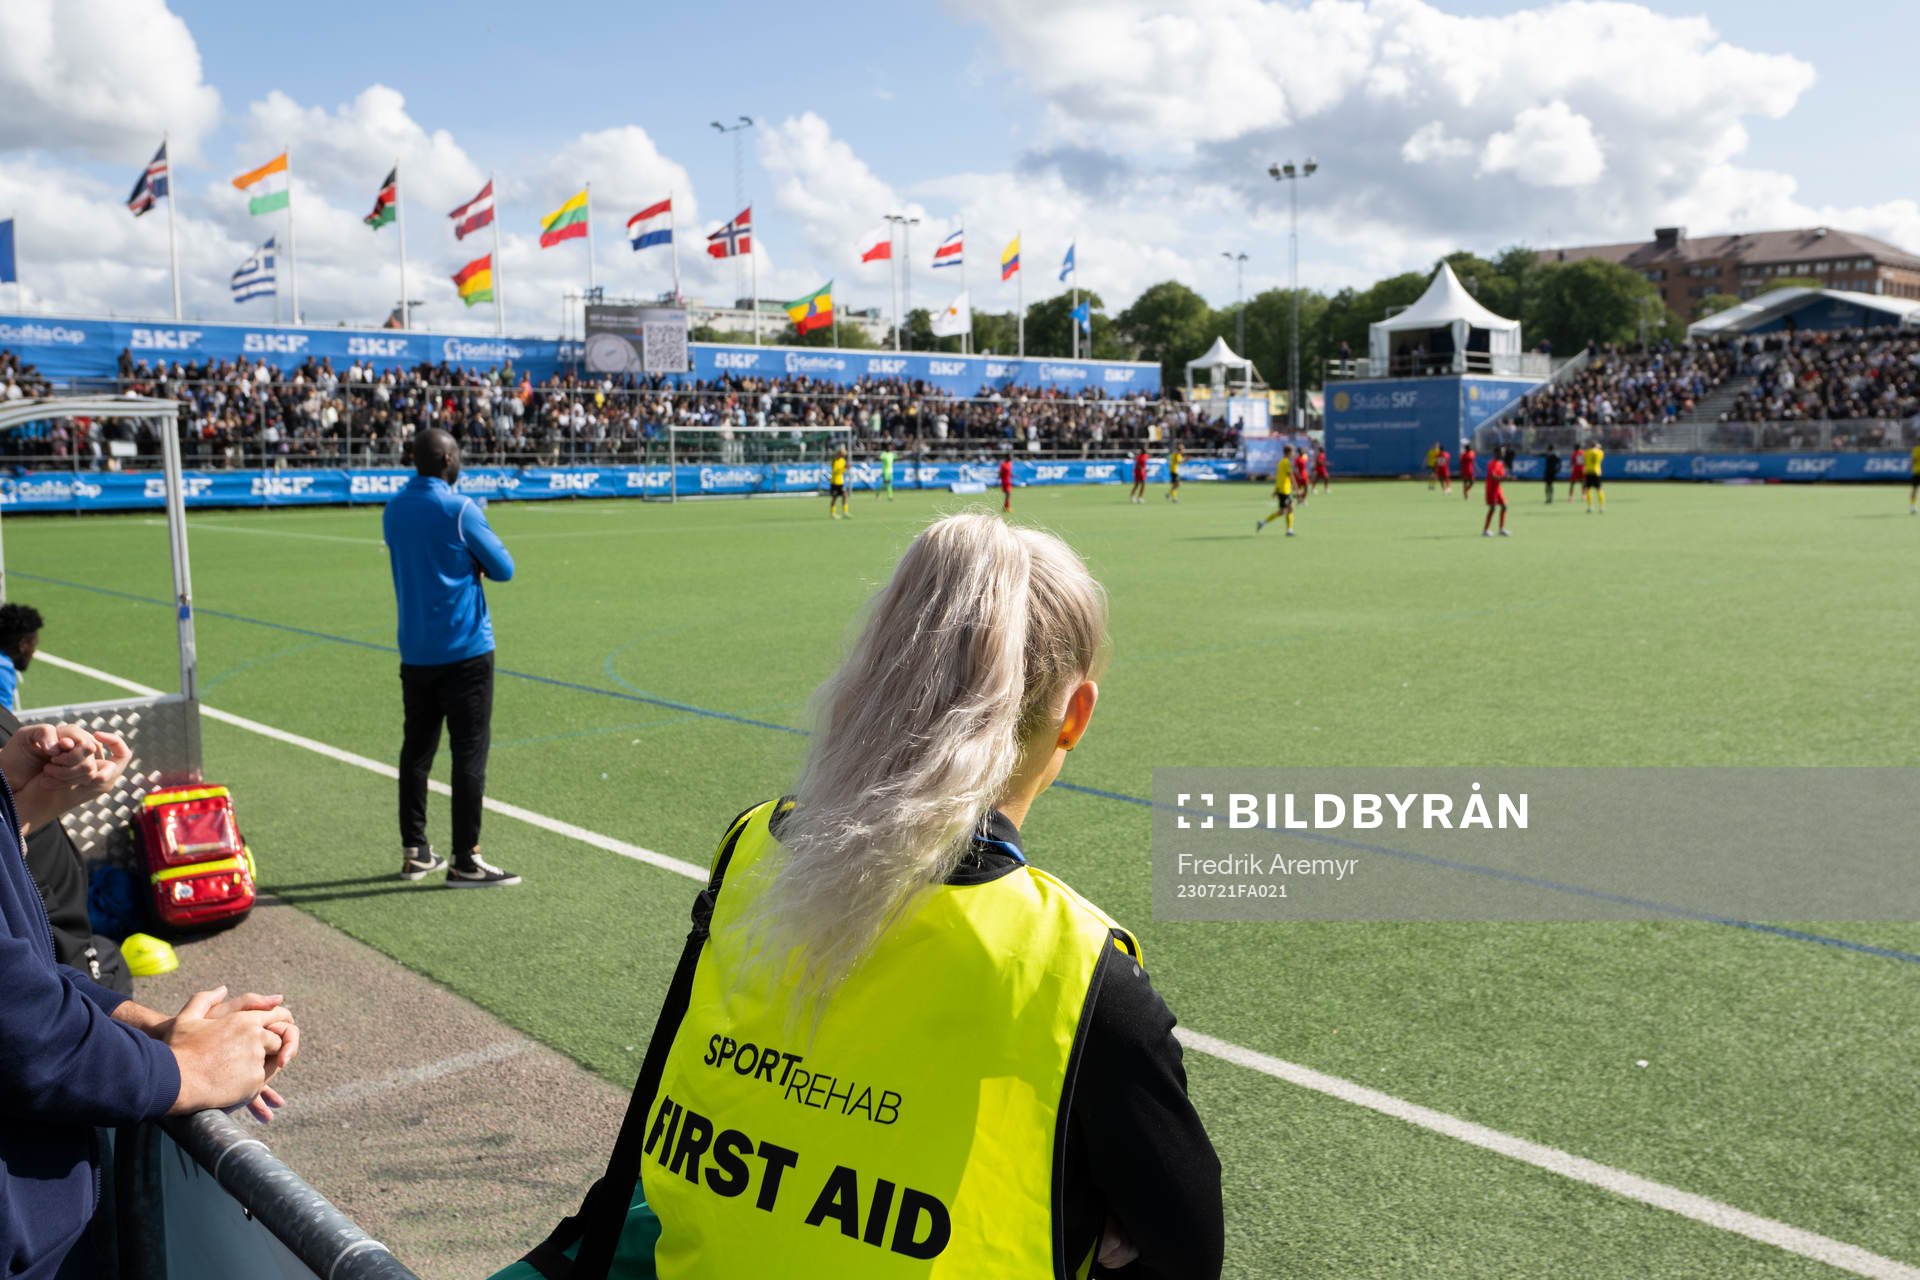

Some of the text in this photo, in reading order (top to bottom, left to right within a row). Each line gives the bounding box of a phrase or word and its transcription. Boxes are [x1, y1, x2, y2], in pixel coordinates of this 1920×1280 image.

[130, 329, 202, 349] SKF
[243, 334, 309, 353] SKF
[348, 337, 407, 356] SKF
[715, 352, 760, 369] SKF
[867, 358, 907, 373] SKF
[929, 361, 966, 376] SKF
[1104, 368, 1135, 382] SKF
[1391, 391, 1418, 408] SKF
[1624, 460, 1668, 473] SKF
[1786, 458, 1836, 472] SKF
[144, 479, 213, 497] SF
[251, 476, 314, 495] SKF
[351, 476, 410, 494] SKF
[549, 473, 599, 489] SKF
[627, 472, 673, 488] SKF
[643, 1094, 952, 1260] FIRST AID
